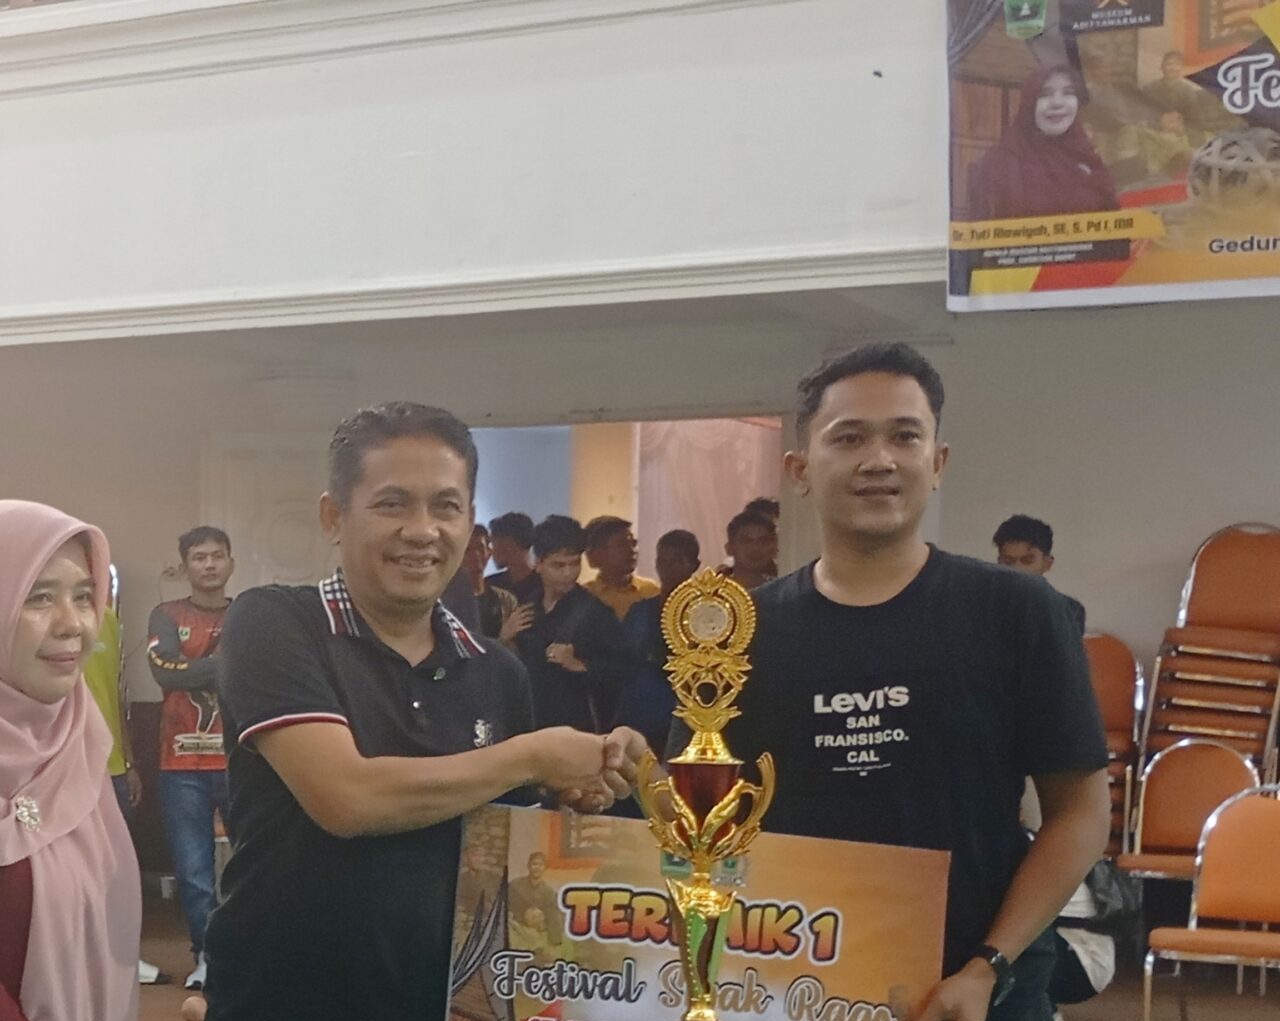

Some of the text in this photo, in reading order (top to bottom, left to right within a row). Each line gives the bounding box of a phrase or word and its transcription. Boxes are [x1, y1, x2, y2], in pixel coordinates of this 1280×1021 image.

[815, 729, 910, 748] FRANSISCO.
[846, 714, 880, 729] SAN
[560, 885, 840, 963] TERIK 1
[490, 950, 646, 1004] Festival
[658, 957, 774, 1016] Sak
